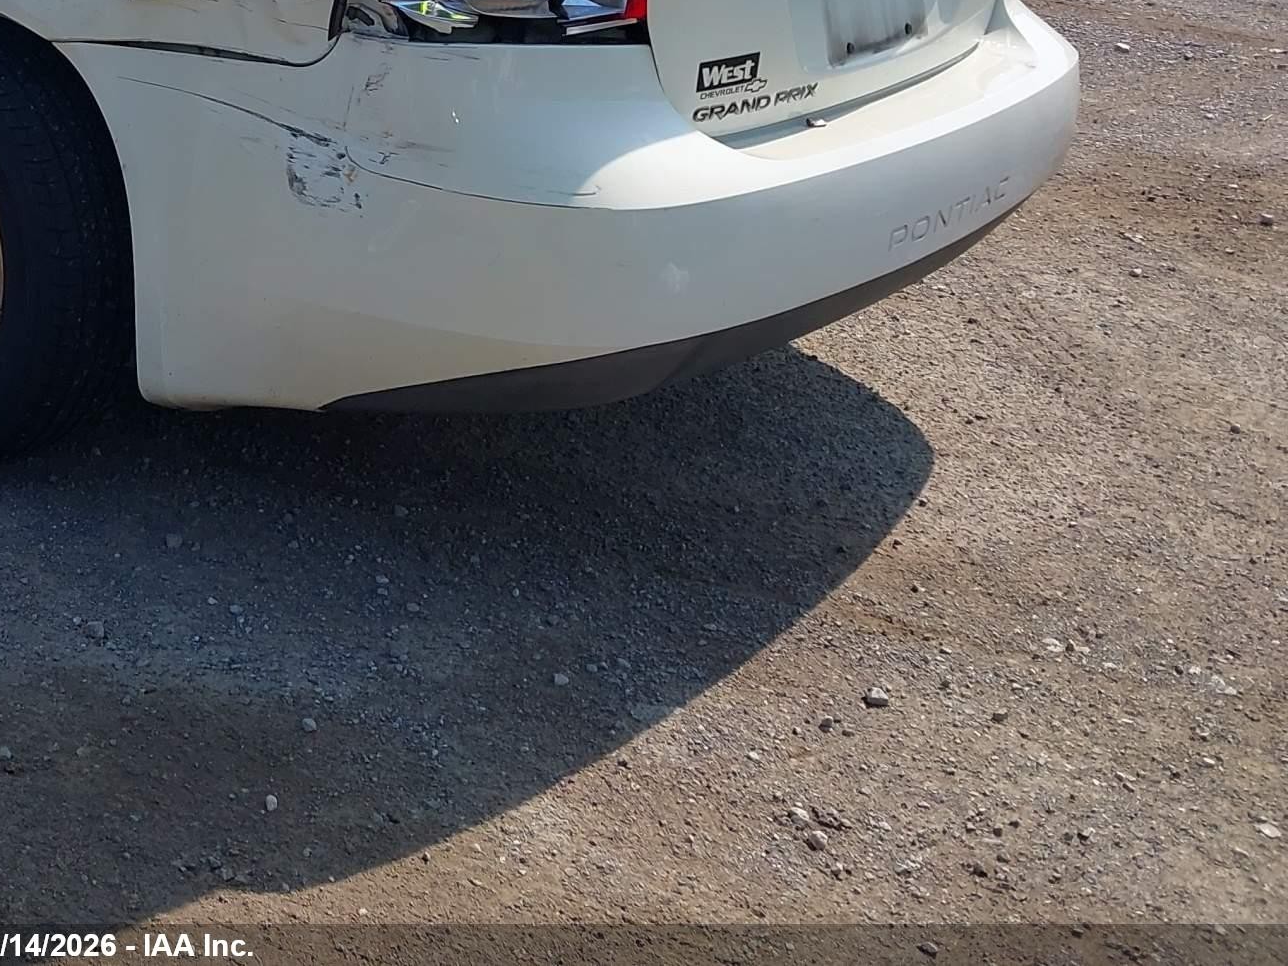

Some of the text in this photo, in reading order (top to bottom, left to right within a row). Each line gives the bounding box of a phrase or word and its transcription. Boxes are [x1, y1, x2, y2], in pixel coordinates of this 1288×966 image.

[693, 82, 818, 122] GRAND PRIX
[699, 85, 745, 100] CHEVROLET
[888, 175, 1010, 252] PONTIAC
